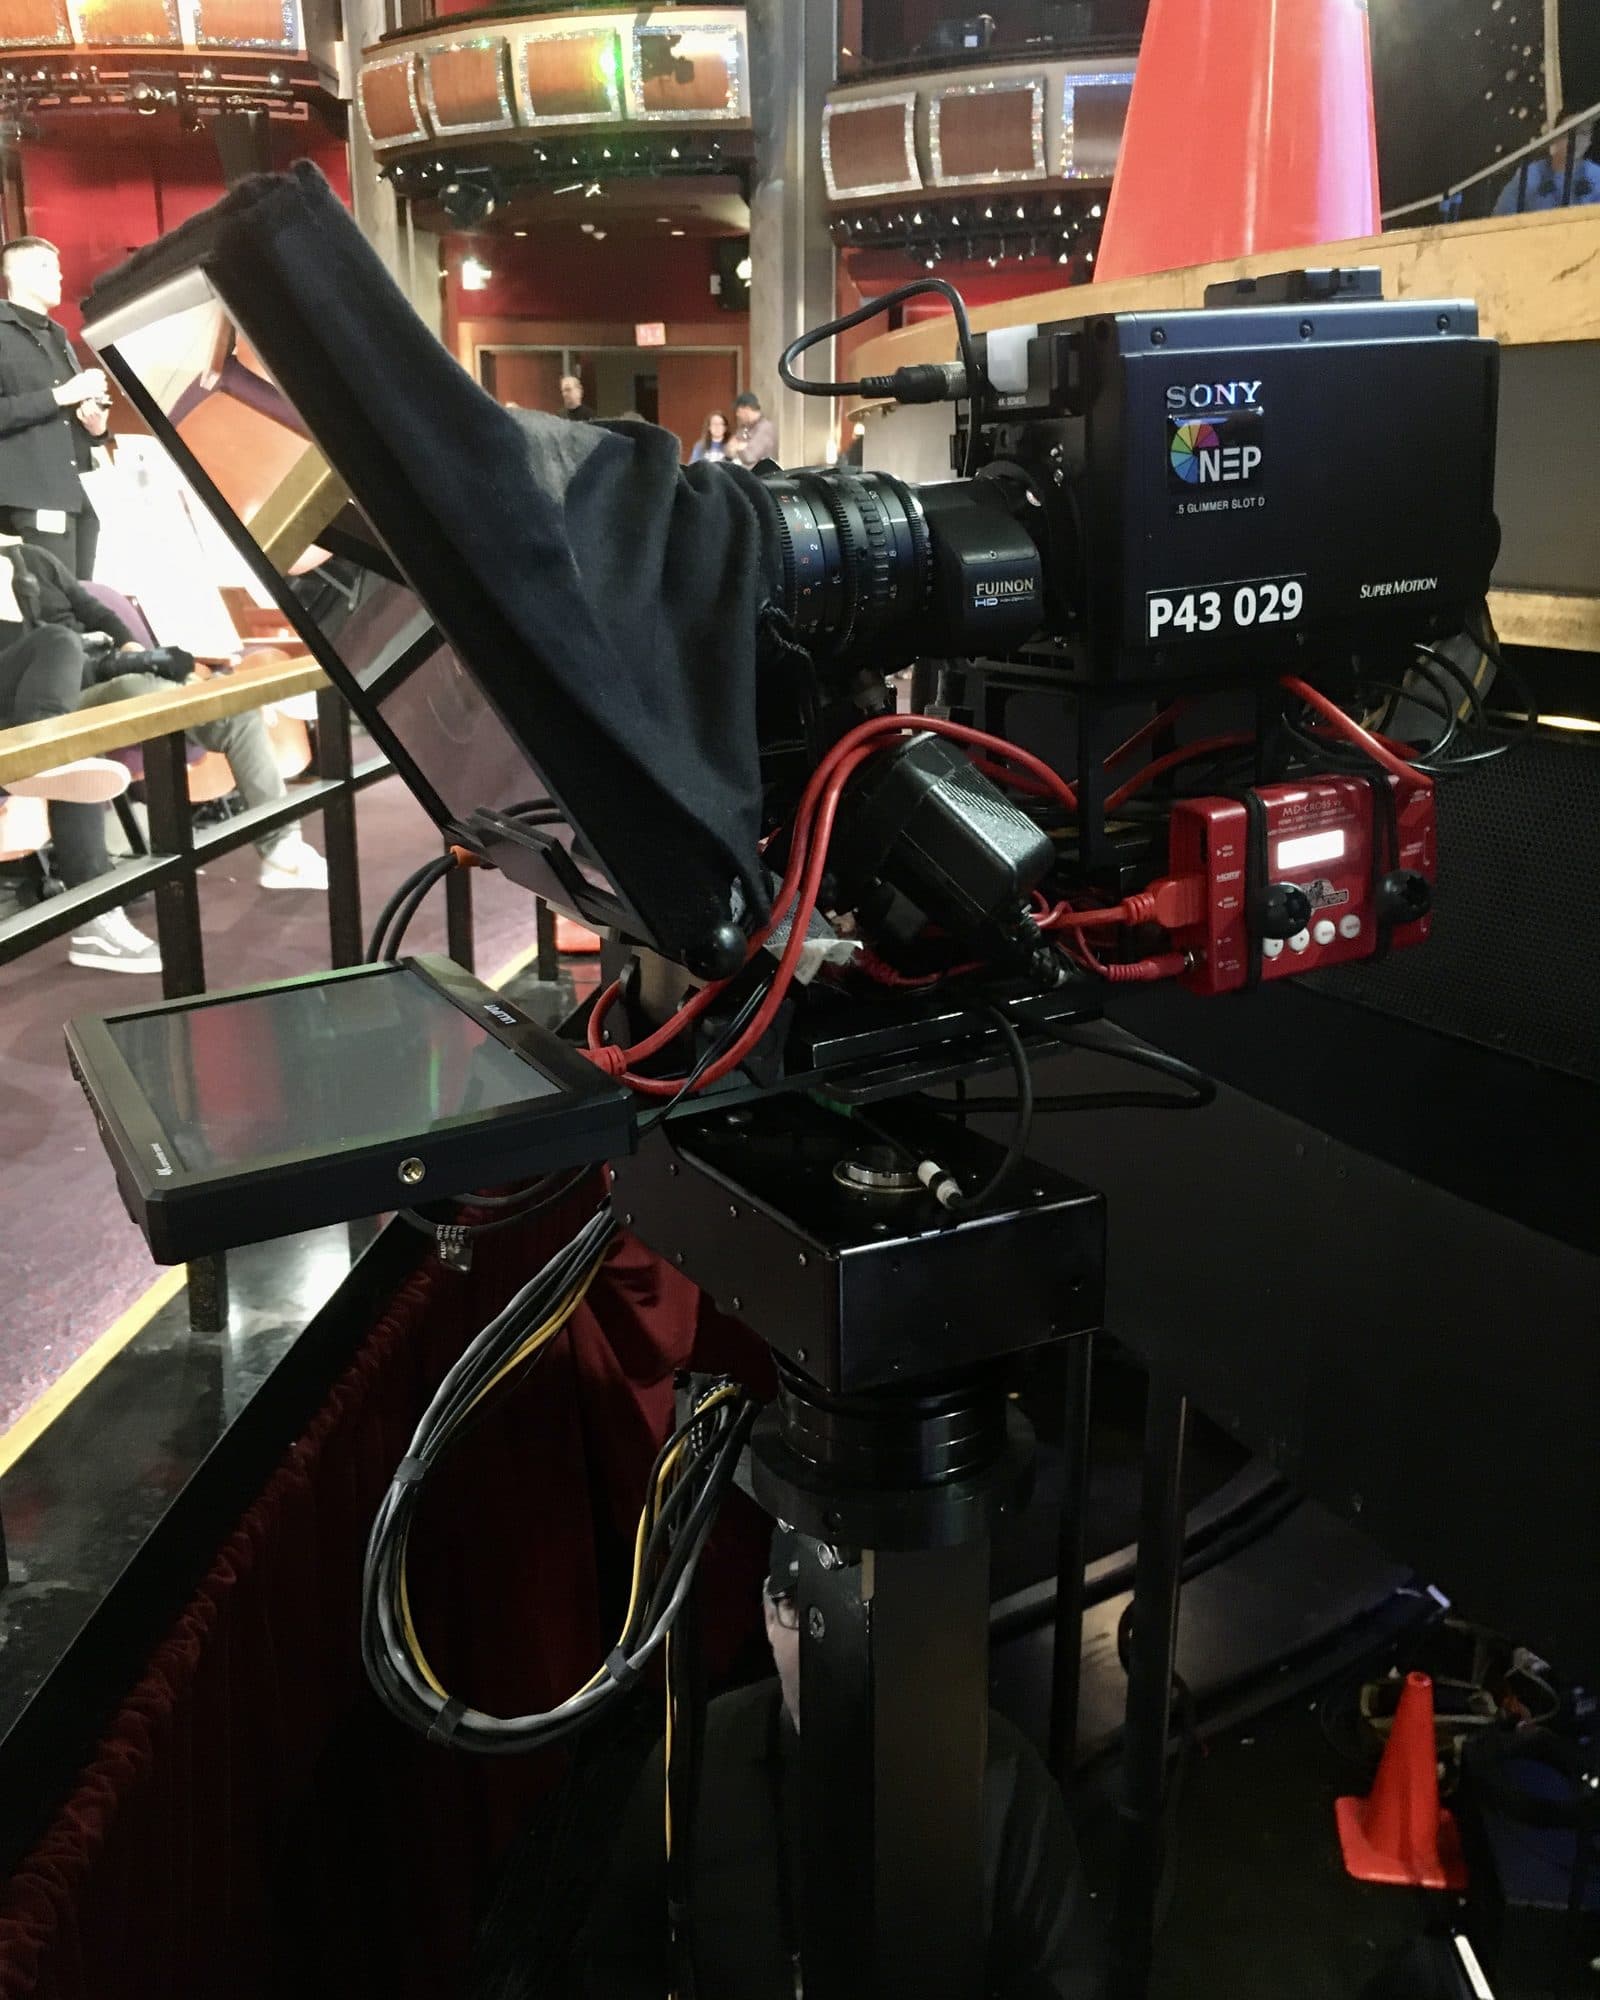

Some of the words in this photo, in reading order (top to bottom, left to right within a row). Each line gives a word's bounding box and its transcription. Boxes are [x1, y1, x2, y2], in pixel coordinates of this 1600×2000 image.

[1166, 380, 1263, 409] SONY
[1199, 446, 1262, 483] NEP
[1187, 499, 1229, 514] GLIMMER
[1231, 497, 1256, 510] SLOT
[810, 543, 819, 551] 2
[976, 578, 1034, 596] FUJINON
[974, 597, 999, 608] HD
[1149, 591, 1222, 639] P43
[1233, 581, 1304, 627] 029
